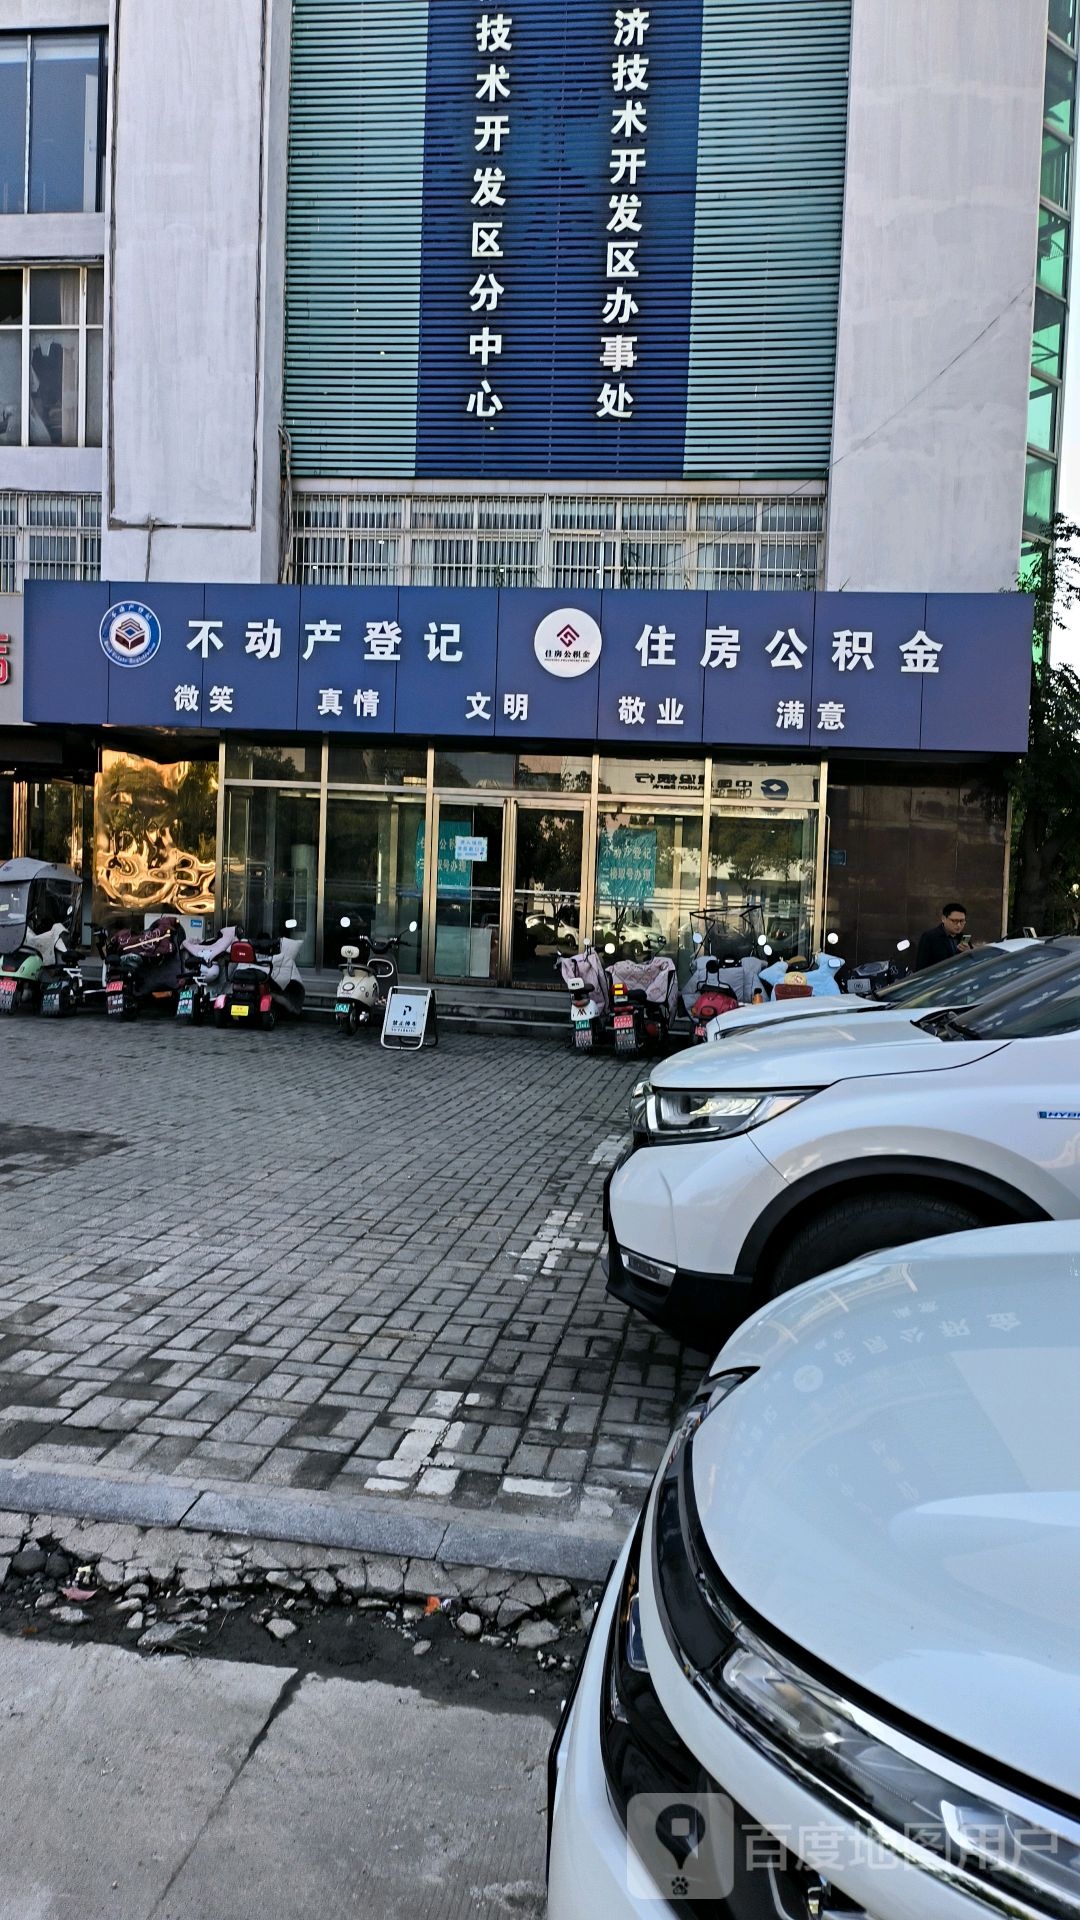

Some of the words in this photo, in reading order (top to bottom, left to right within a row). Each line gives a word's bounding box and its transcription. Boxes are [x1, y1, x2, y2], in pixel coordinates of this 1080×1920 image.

[466, 0, 512, 417] 技术开发区分中心
[596, 8, 650, 418] 济技术开发区办事处
[186, 619, 463, 662] 不动产登记
[545, 650, 591, 658] 住房公积金
[635, 625, 944, 673] 住房公积金
[174, 685, 234, 713] 微笑
[317, 688, 380, 717] 真情
[465, 692, 529, 721] 文明
[618, 696, 684, 725] 敬业
[776, 700, 846, 730] 满意
